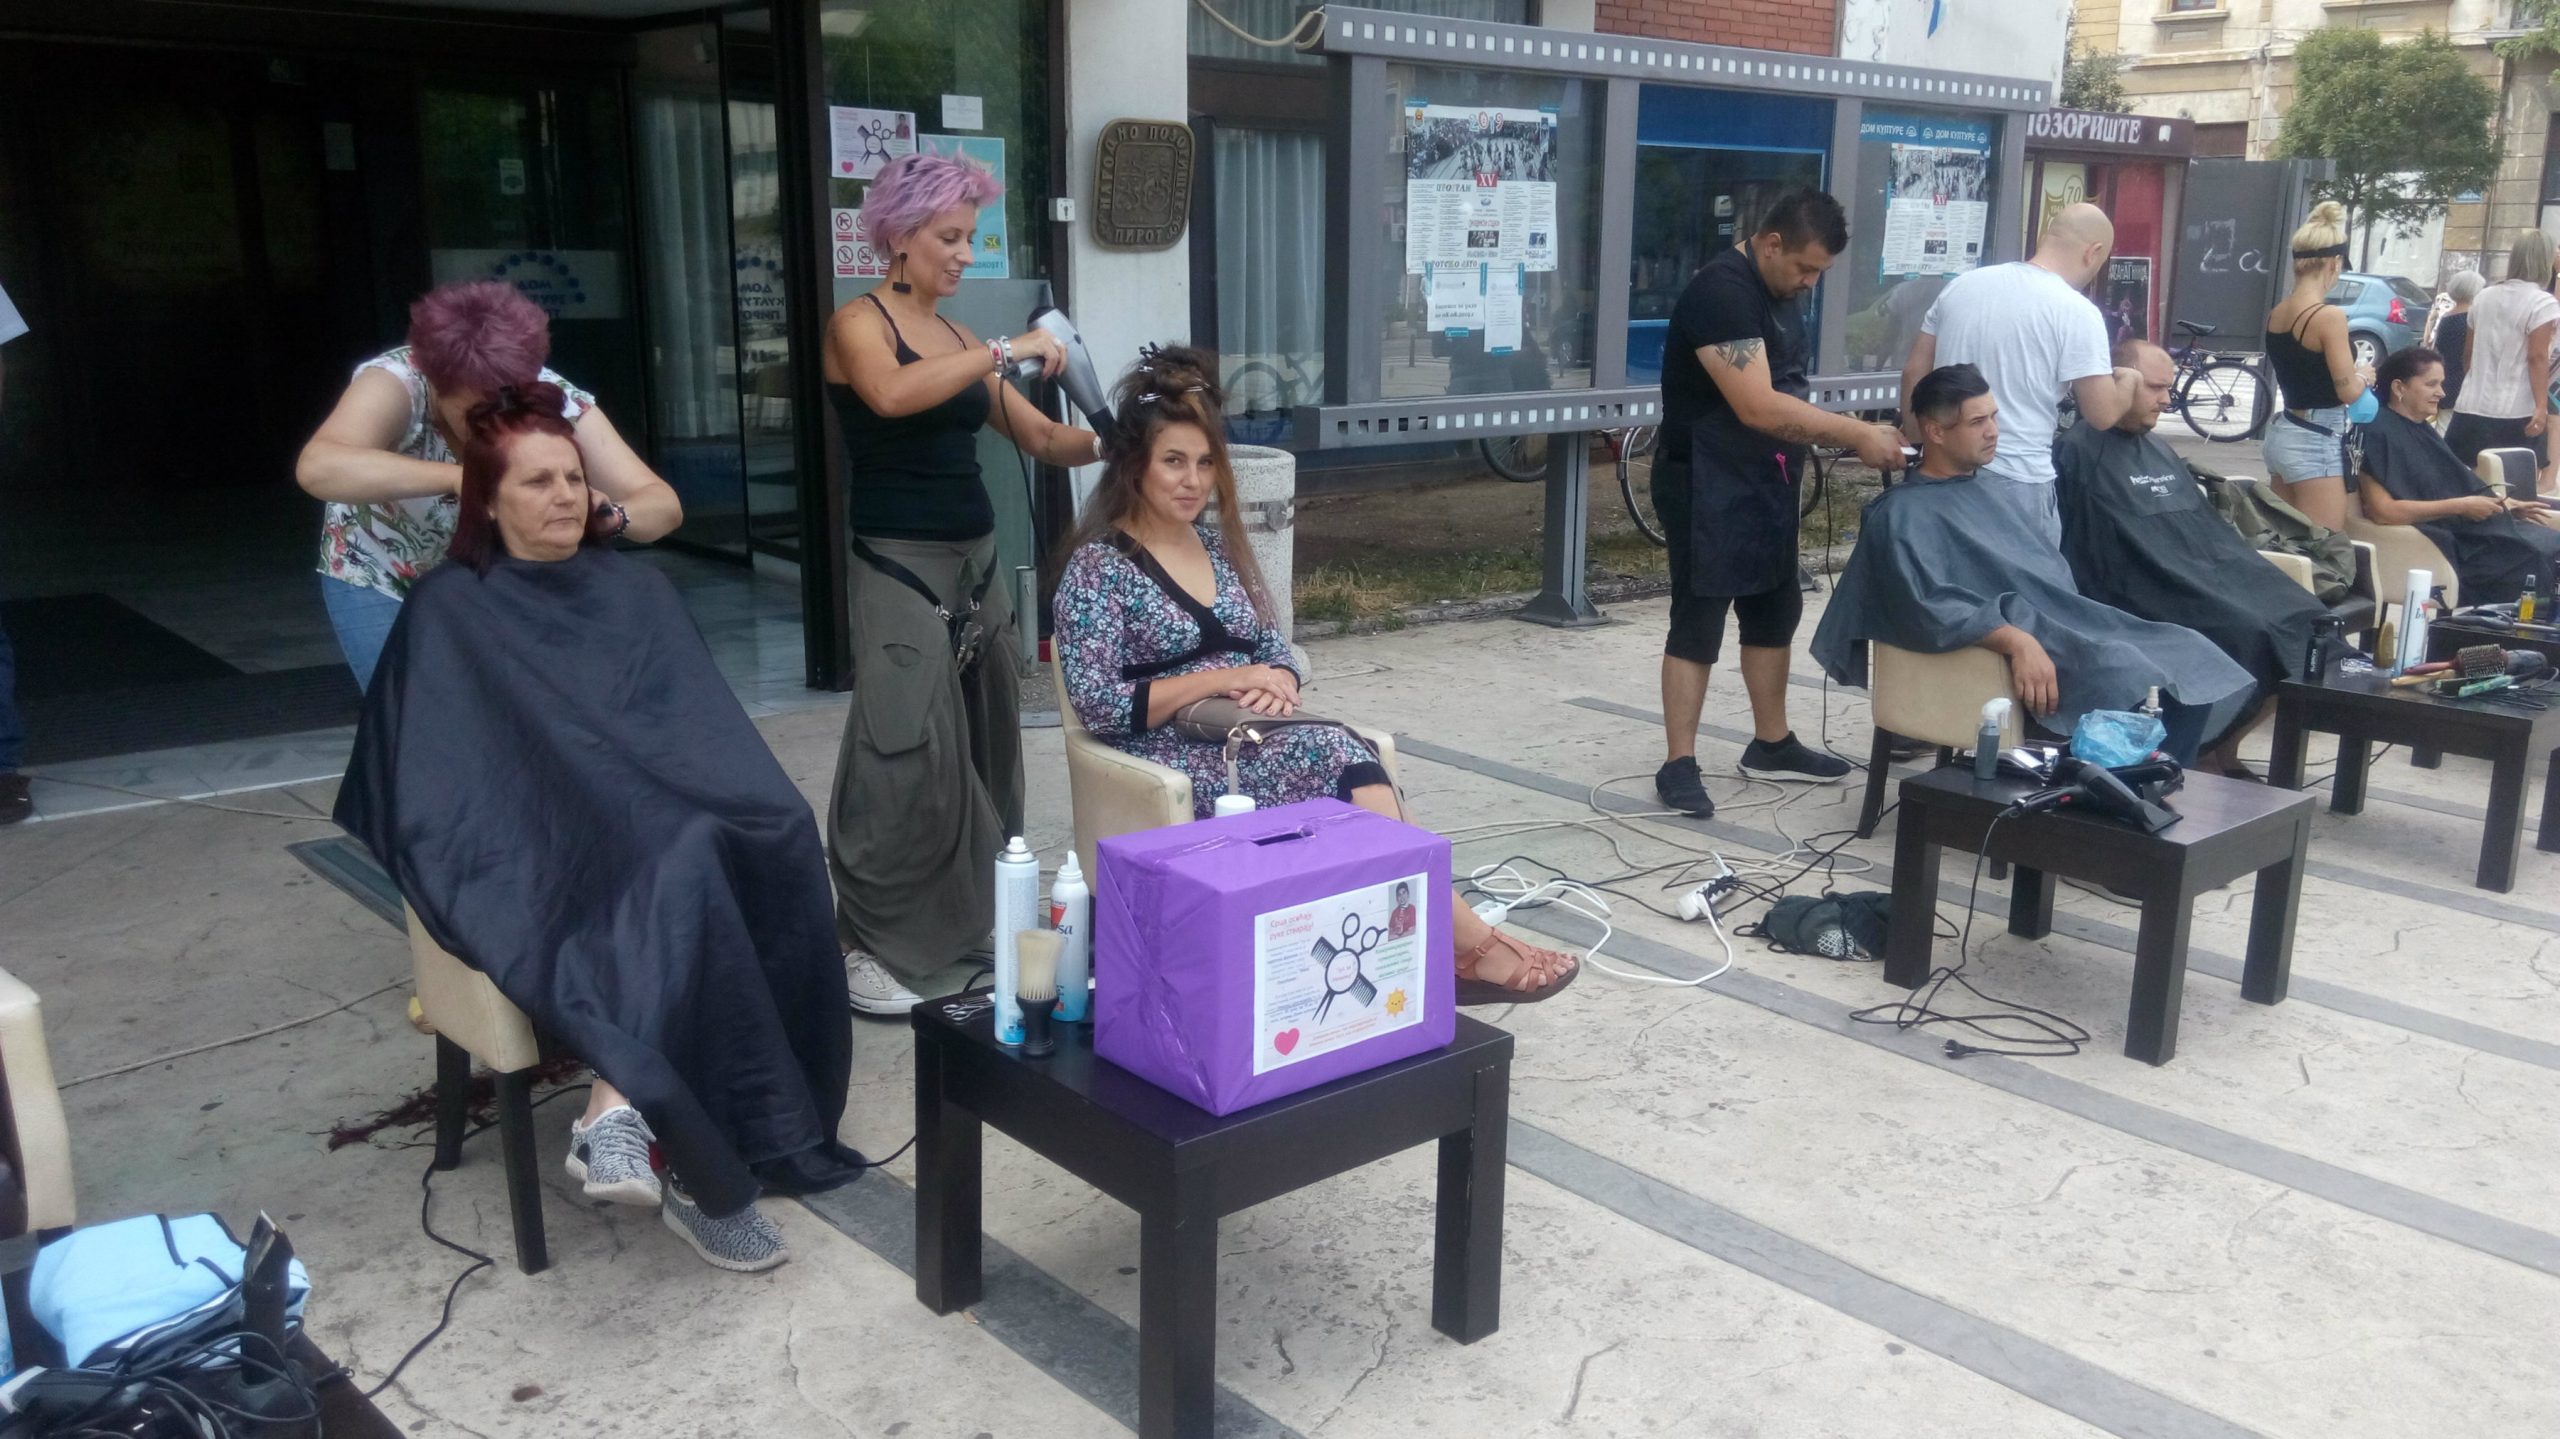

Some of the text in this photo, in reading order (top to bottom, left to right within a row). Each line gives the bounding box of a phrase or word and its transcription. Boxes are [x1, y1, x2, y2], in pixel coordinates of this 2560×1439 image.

[1469, 111, 1504, 134] 2019
[1860, 123, 1904, 135] ДОМ КУЛТУРЕ
[1935, 129, 1975, 141] ДОМ КУЛТУРЕ
[1479, 174, 1496, 187] XV
[2066, 185, 2082, 203] 70
[1116, 228, 1162, 243] ПИРОТ
[1270, 916, 1287, 928] Срца
[1269, 930, 1284, 941] руке
